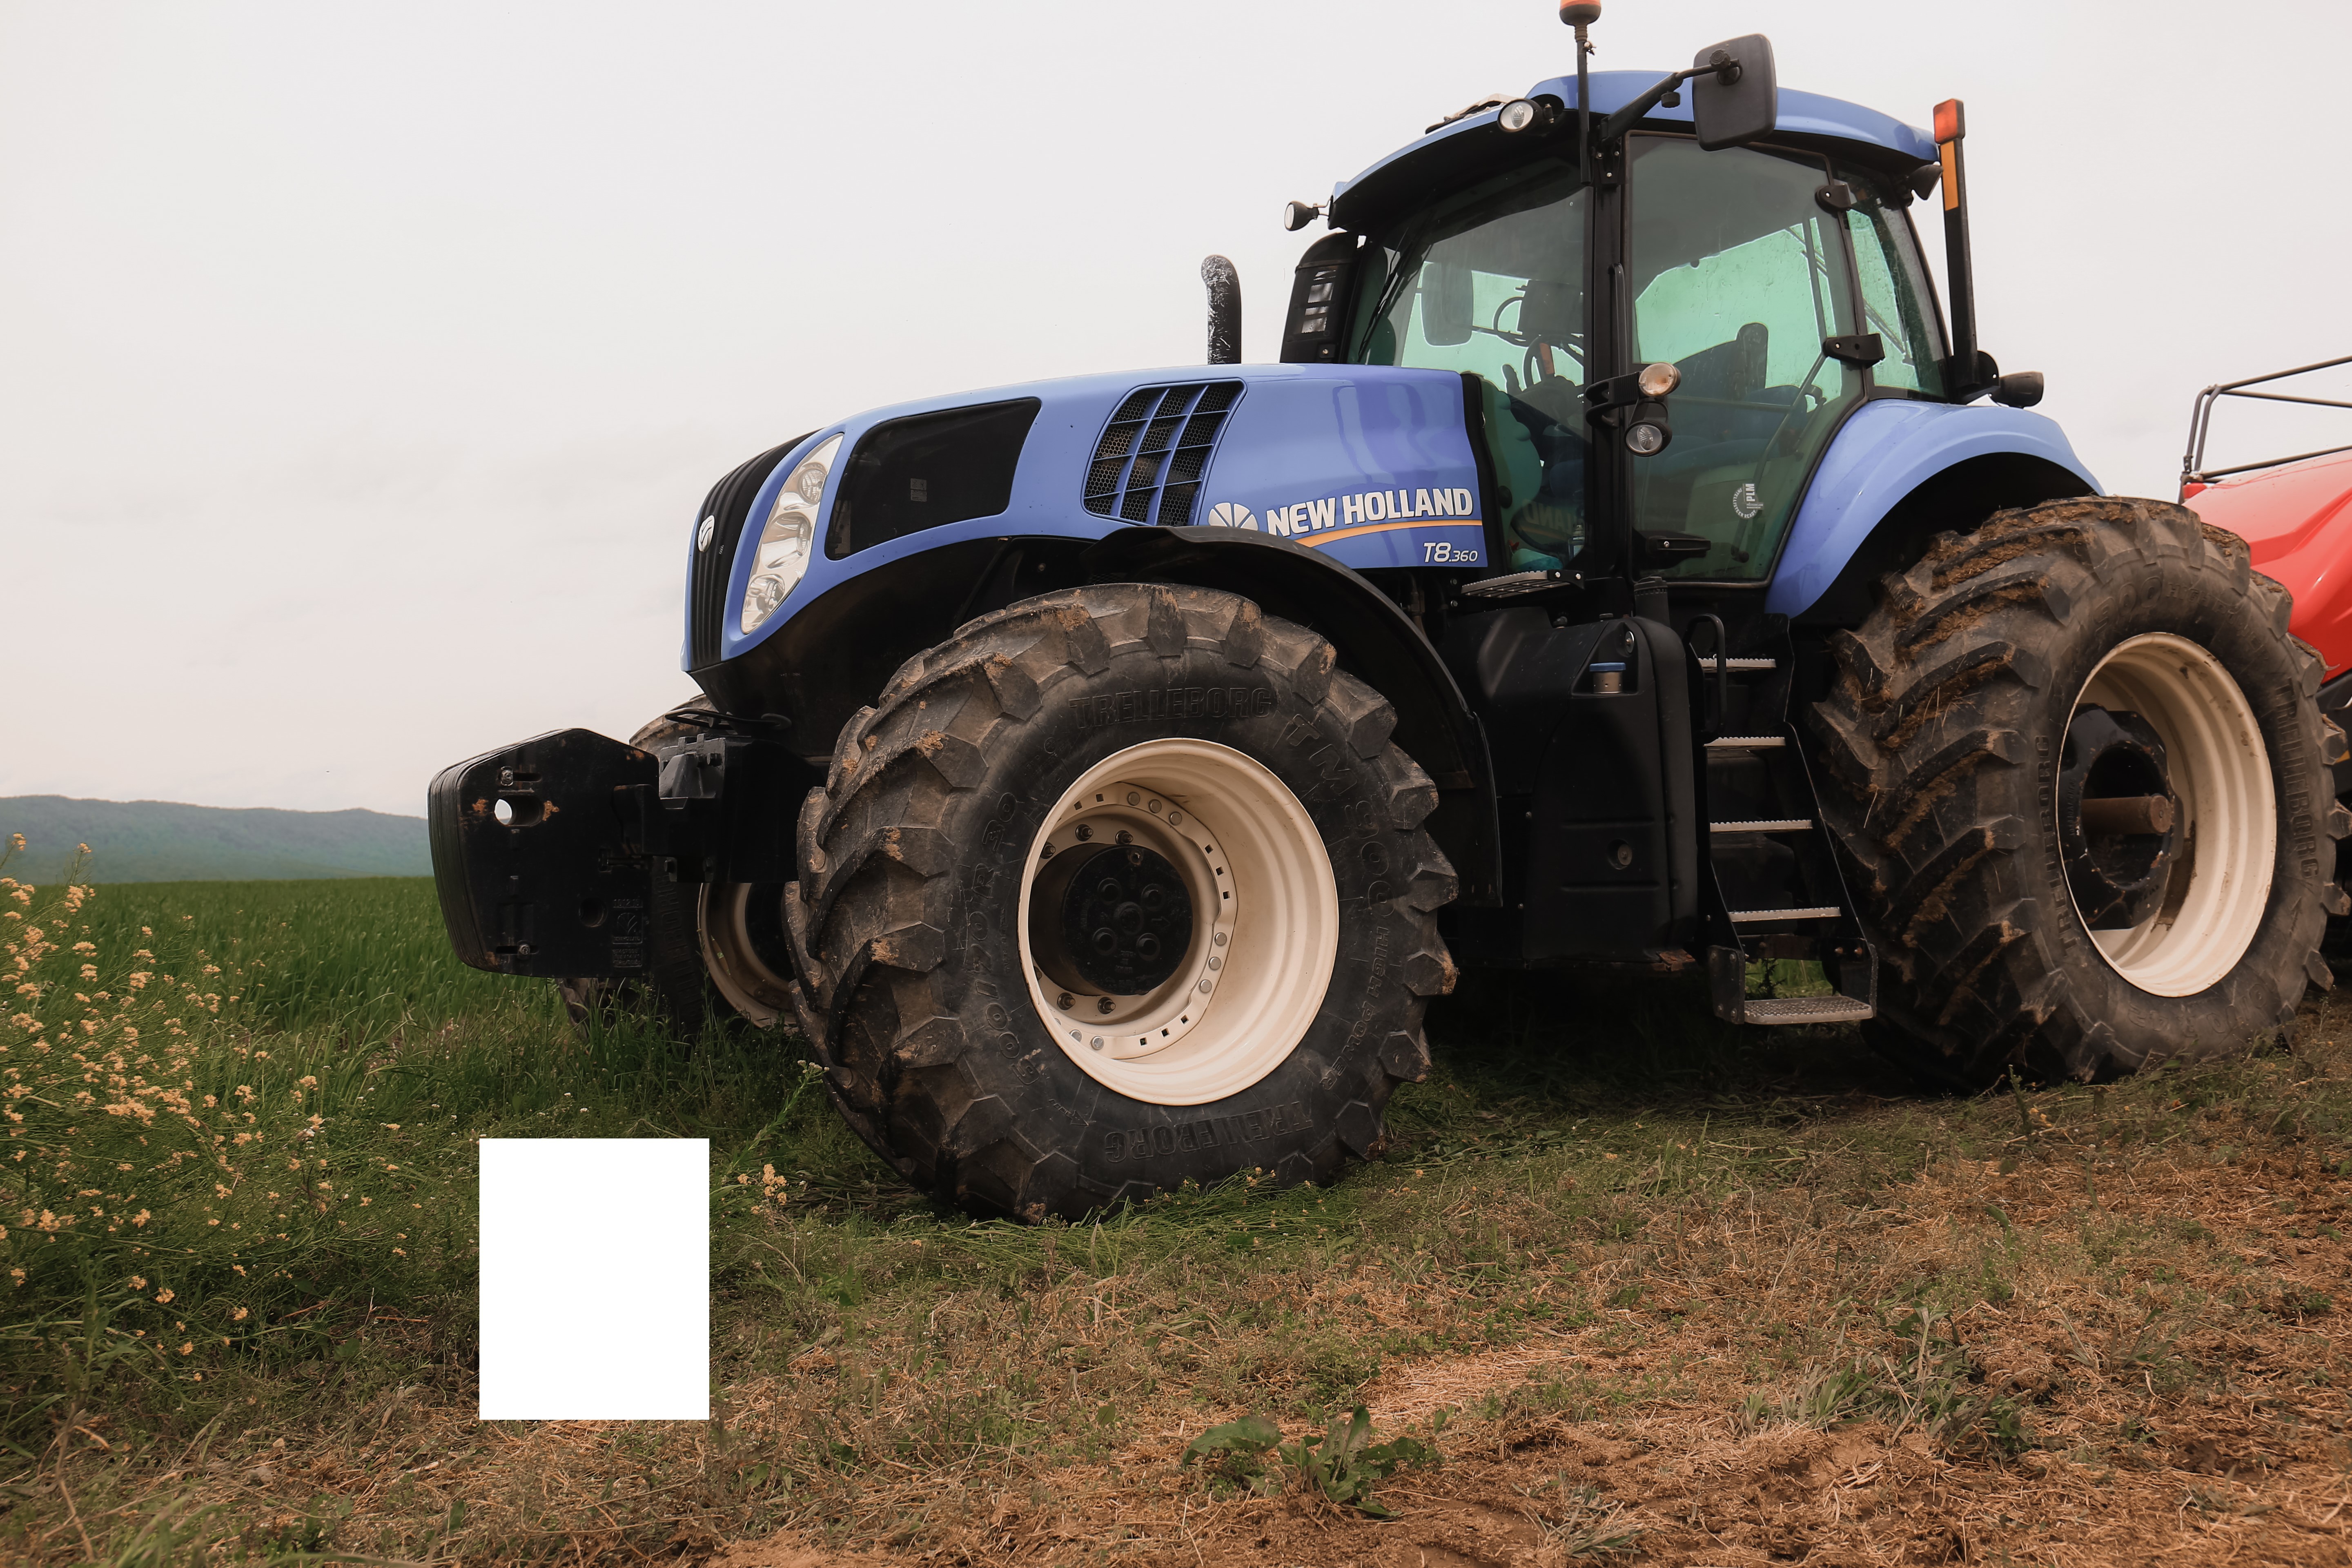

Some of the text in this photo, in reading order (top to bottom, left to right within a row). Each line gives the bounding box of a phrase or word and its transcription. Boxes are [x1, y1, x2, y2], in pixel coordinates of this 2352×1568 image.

[1266, 488, 1473, 537] NEW HOLLAND
[1744, 509, 1756, 519] READY
[1745, 483, 1755, 502] PLM
[2093, 575, 2163, 635] 900
[2166, 581, 2211, 608] HIGH
[1069, 687, 1272, 730] TRELLEBORG
[2275, 676, 2320, 880] TRELLEBORG
[655, 875, 704, 1026] RELLEBORG
[1366, 926, 1390, 999] HIGH
[1319, 1001, 1375, 1091] POWER
[1104, 1101, 1314, 1163] TRELLEBORG
